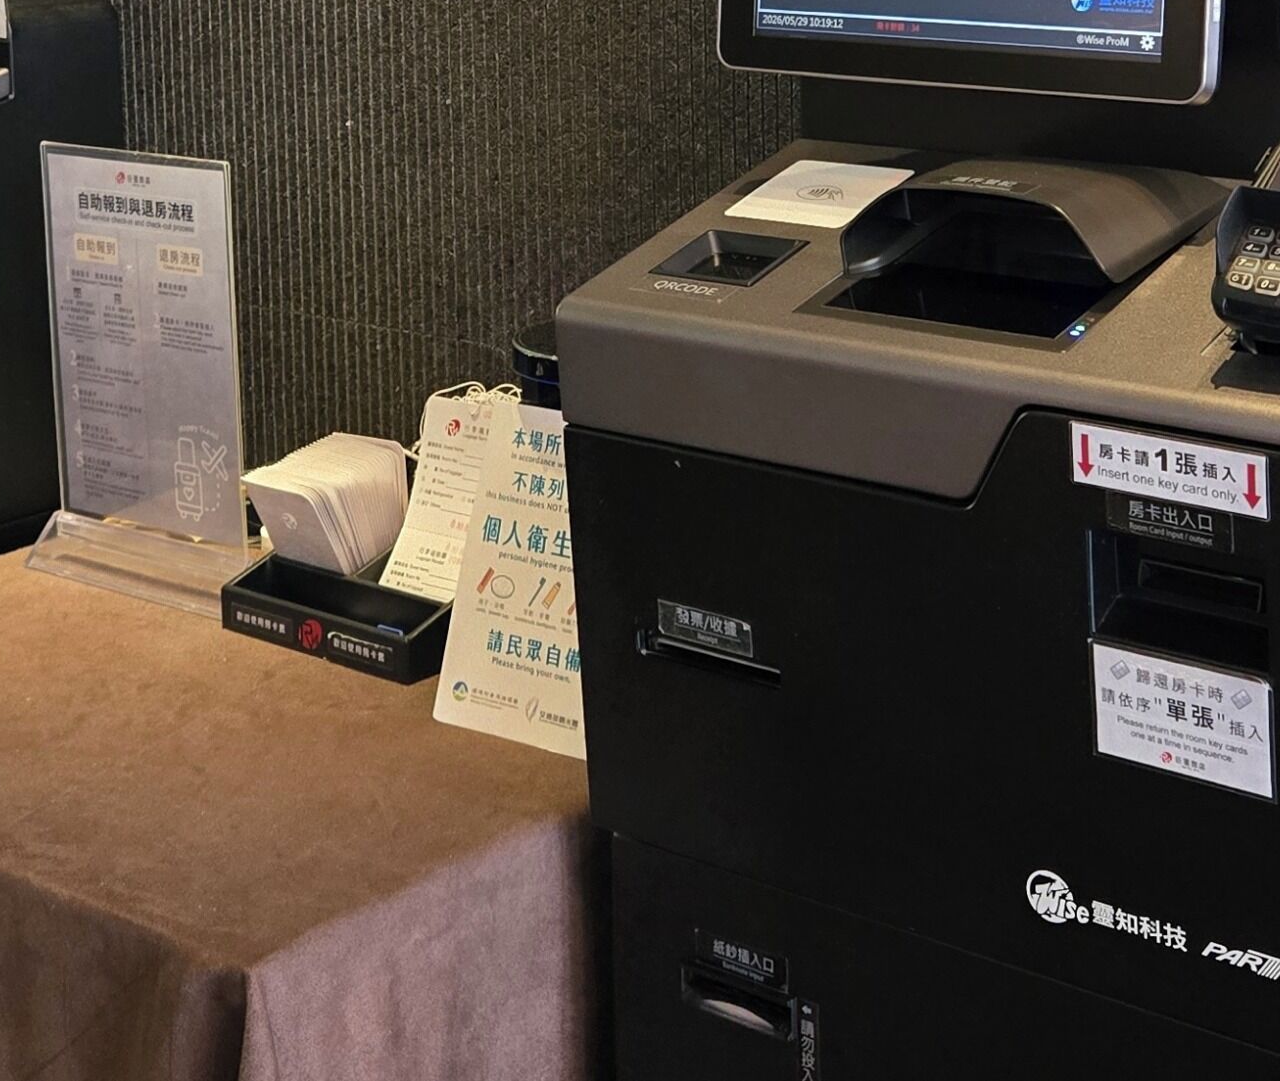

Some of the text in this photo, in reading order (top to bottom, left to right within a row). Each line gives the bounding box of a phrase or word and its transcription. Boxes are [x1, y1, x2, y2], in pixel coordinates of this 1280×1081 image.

[762, 14, 844, 29] 2026/05/29 10:19:12
[1105, 36, 1130, 47] ProM
[78, 192, 195, 222] 自助報到與退房流程
[654, 280, 719, 296] QRCODE
[512, 427, 562, 456] 本場所
[518, 453, 556, 467] accordance
[1099, 443, 1237, 483] 房卡請1張插入
[512, 470, 565, 501] 不陳列
[1098, 465, 1240, 504] Insert one key card only.
[486, 490, 563, 513] this business does NOT
[1128, 499, 1213, 532] 房卡出入口
[482, 514, 572, 560] 個人衛生
[1149, 523, 1165, 537] Card
[498, 550, 528, 565] personal
[530, 555, 558, 570] hygiene
[487, 629, 582, 673] 請民眾自備
[492, 656, 514, 669] Please
[516, 660, 535, 676] bring
[536, 667, 553, 679] your
[1136, 668, 1224, 703] 歸還房卡時
[1117, 715, 1248, 756] Please return the room key cards
[1130, 729, 1145, 739] one
[1147, 732, 1157, 742] at
[1164, 737, 1182, 750] time
[1183, 741, 1192, 752] in
[1193, 745, 1235, 764] sequence.
[1029, 875, 1090, 924] Wise
[712, 938, 775, 974] 紙鈔插入口
